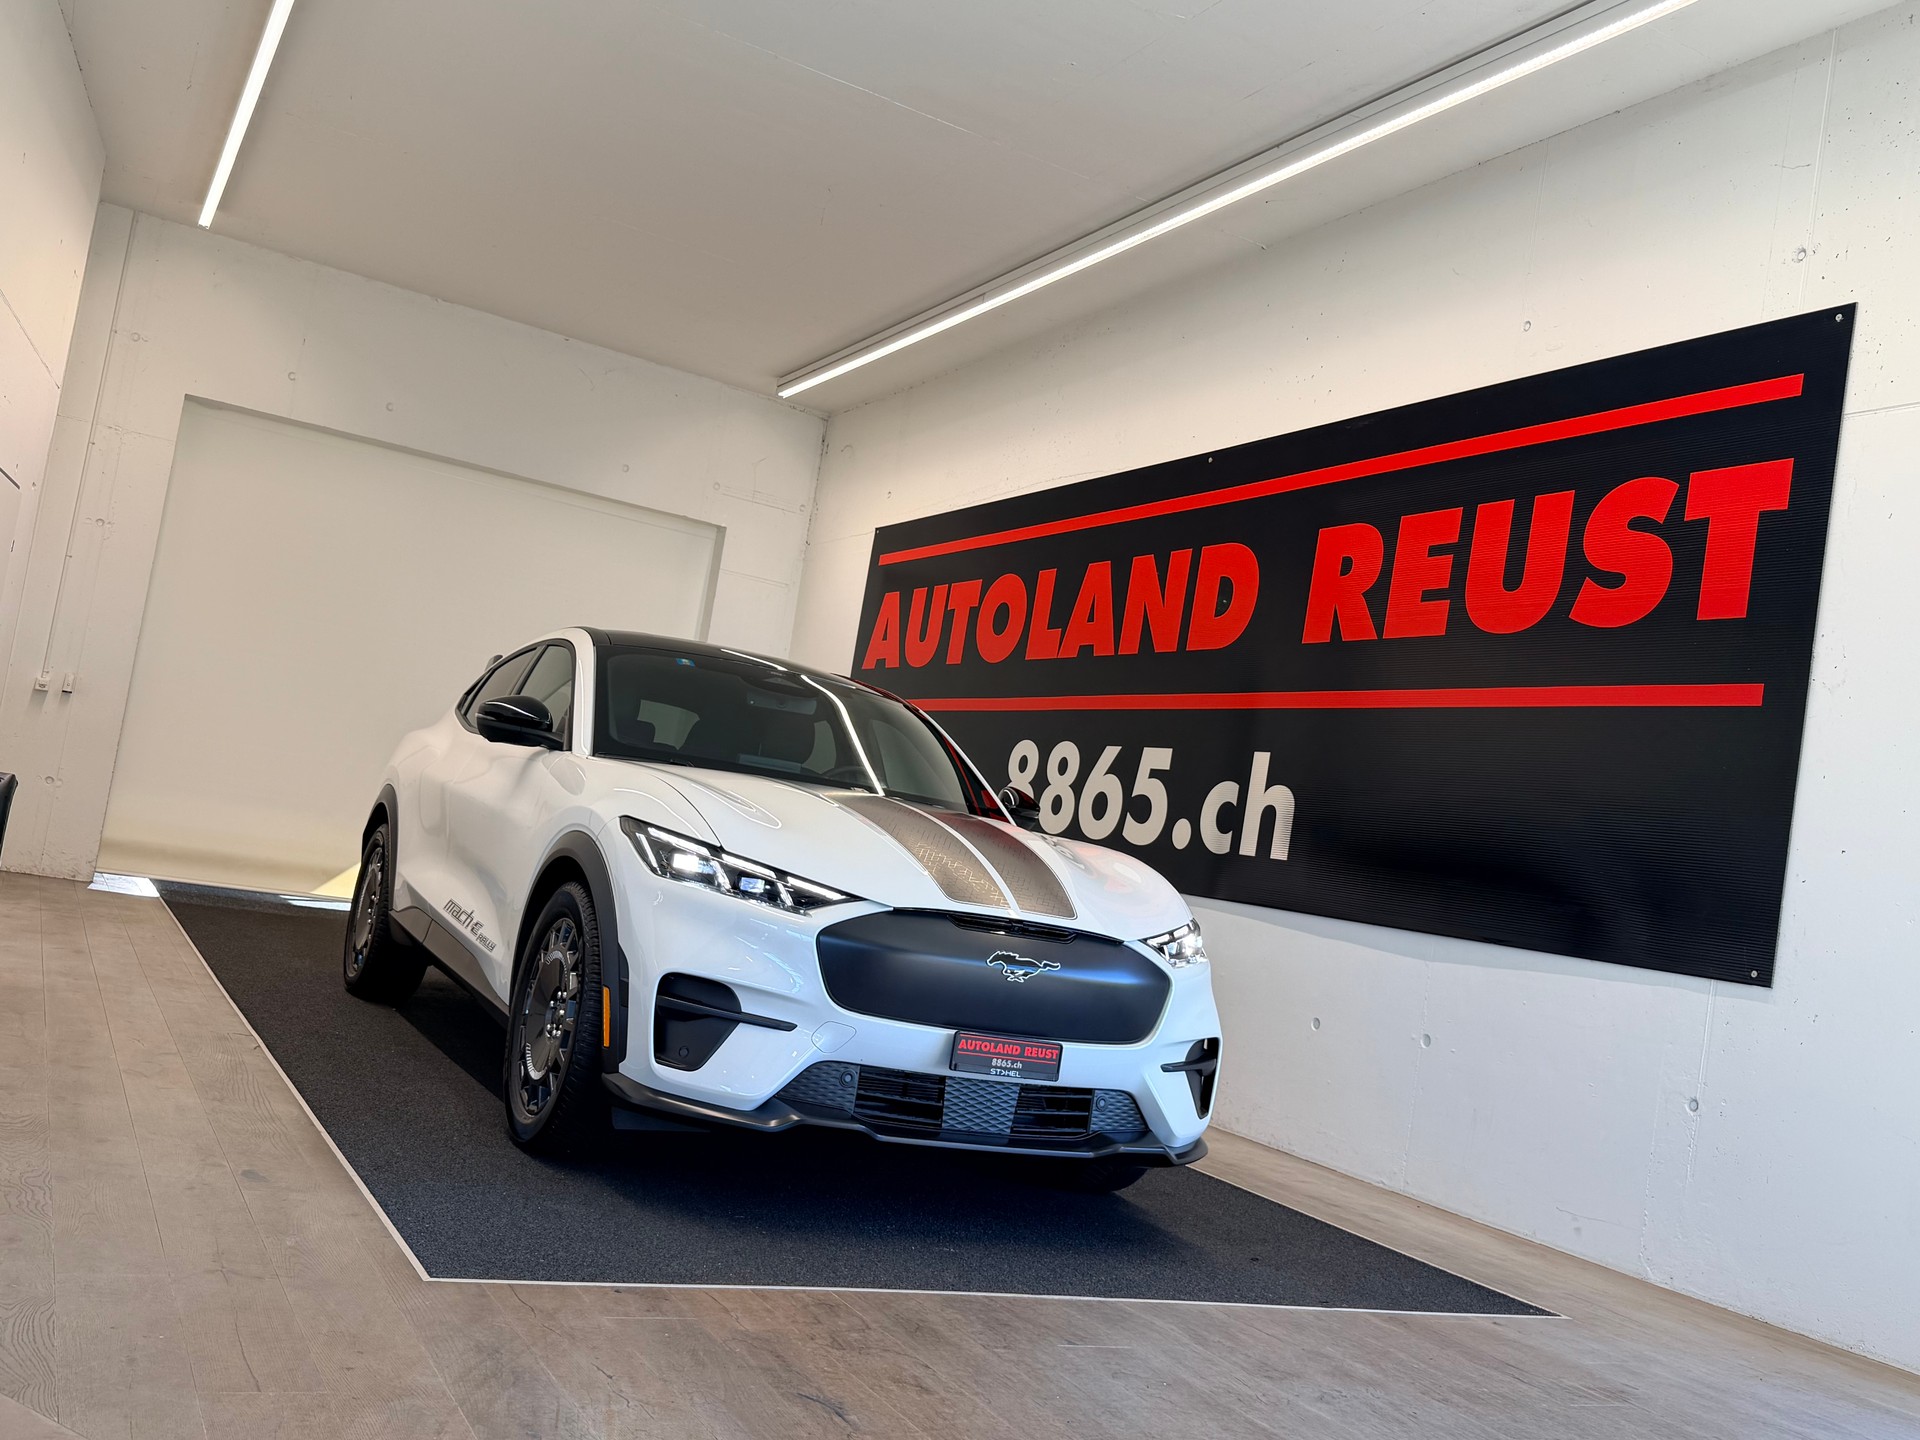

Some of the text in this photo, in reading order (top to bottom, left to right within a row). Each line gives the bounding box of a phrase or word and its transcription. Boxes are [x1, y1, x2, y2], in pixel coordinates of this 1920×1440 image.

[862, 458, 1794, 669] AUTOLAND REUST
[1005, 740, 1294, 860] 8865.ch
[958, 1040, 1059, 1059] AUTOLAND REUST
[991, 1058, 1022, 1069] 8865.ch
